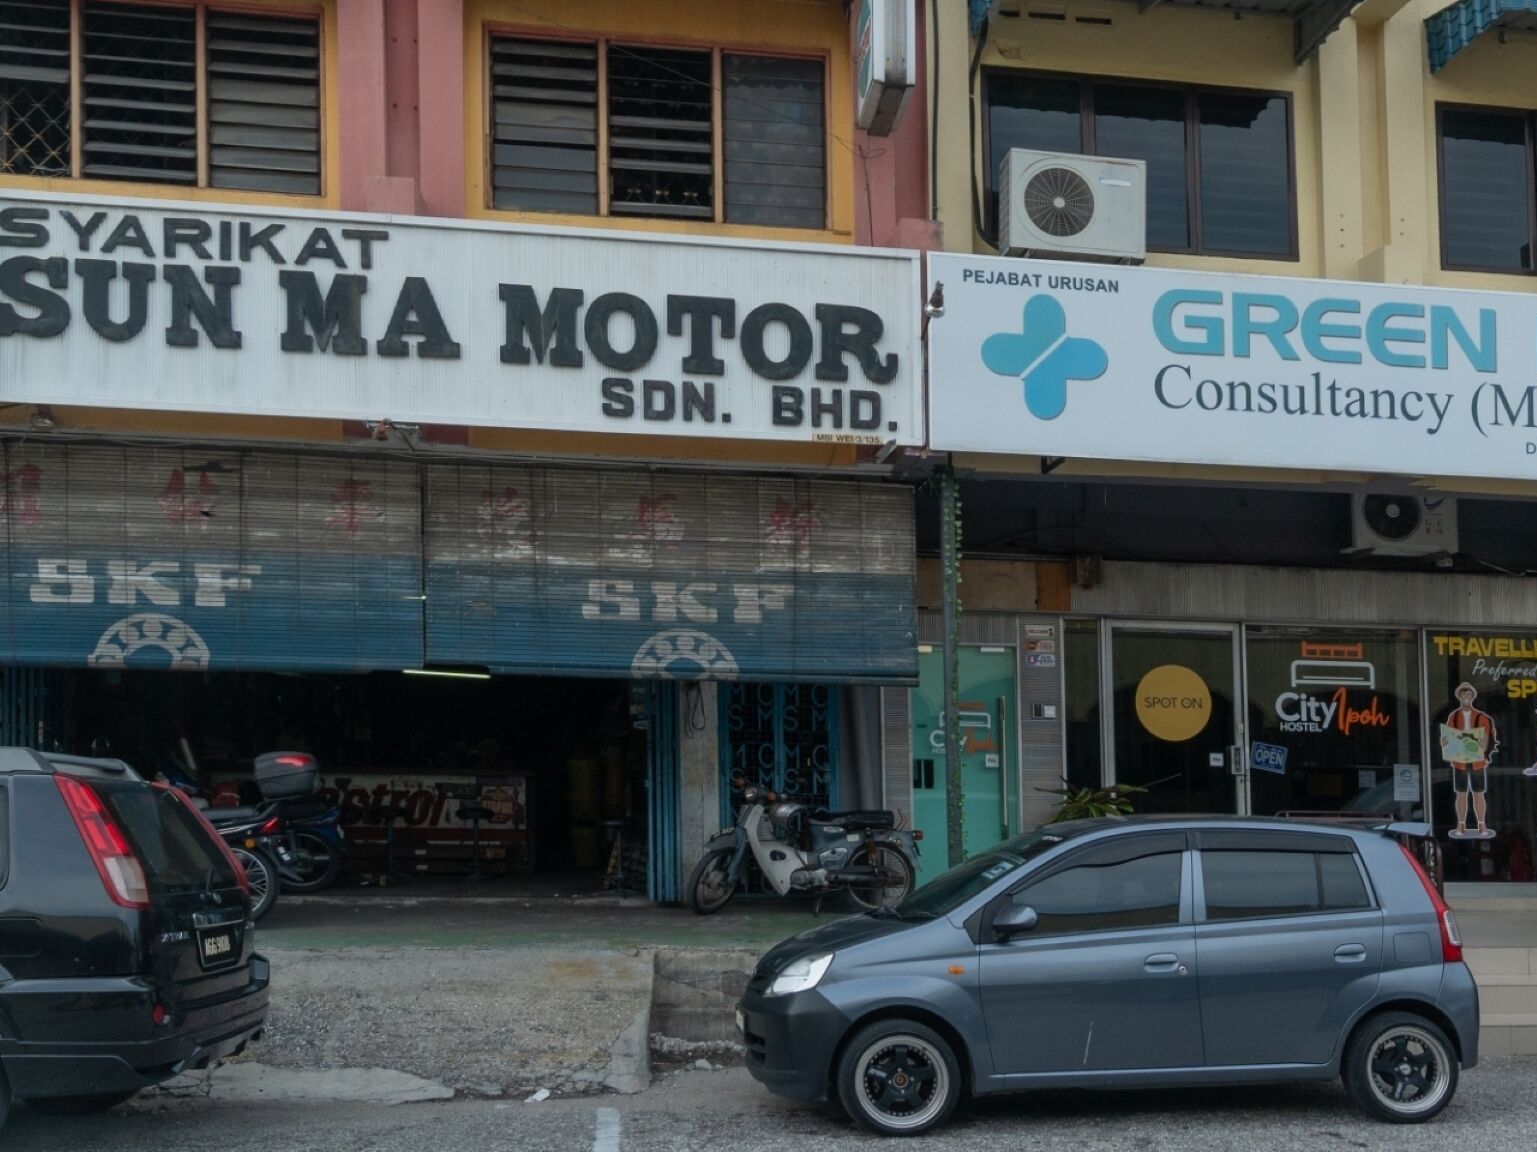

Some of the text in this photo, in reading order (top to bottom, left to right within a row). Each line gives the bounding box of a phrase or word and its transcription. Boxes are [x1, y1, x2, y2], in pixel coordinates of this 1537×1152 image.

[0, 207, 389, 269] SYARIKAT
[963, 269, 1119, 293] PEJABAT URUSAN
[0, 256, 898, 384] SUN MA MOTOR
[1152, 288, 1497, 373] GREEN
[602, 378, 898, 431] SDN. BHD.
[1154, 364, 1454, 435] Consultancy
[30, 558, 262, 607] SKF
[582, 579, 794, 624] SKF
[1144, 696, 1203, 710] SPOT ON
[1275, 687, 1389, 736] City Ipoh
[1280, 722, 1322, 732] HOSTEL
[1255, 749, 1282, 765] OPEN
